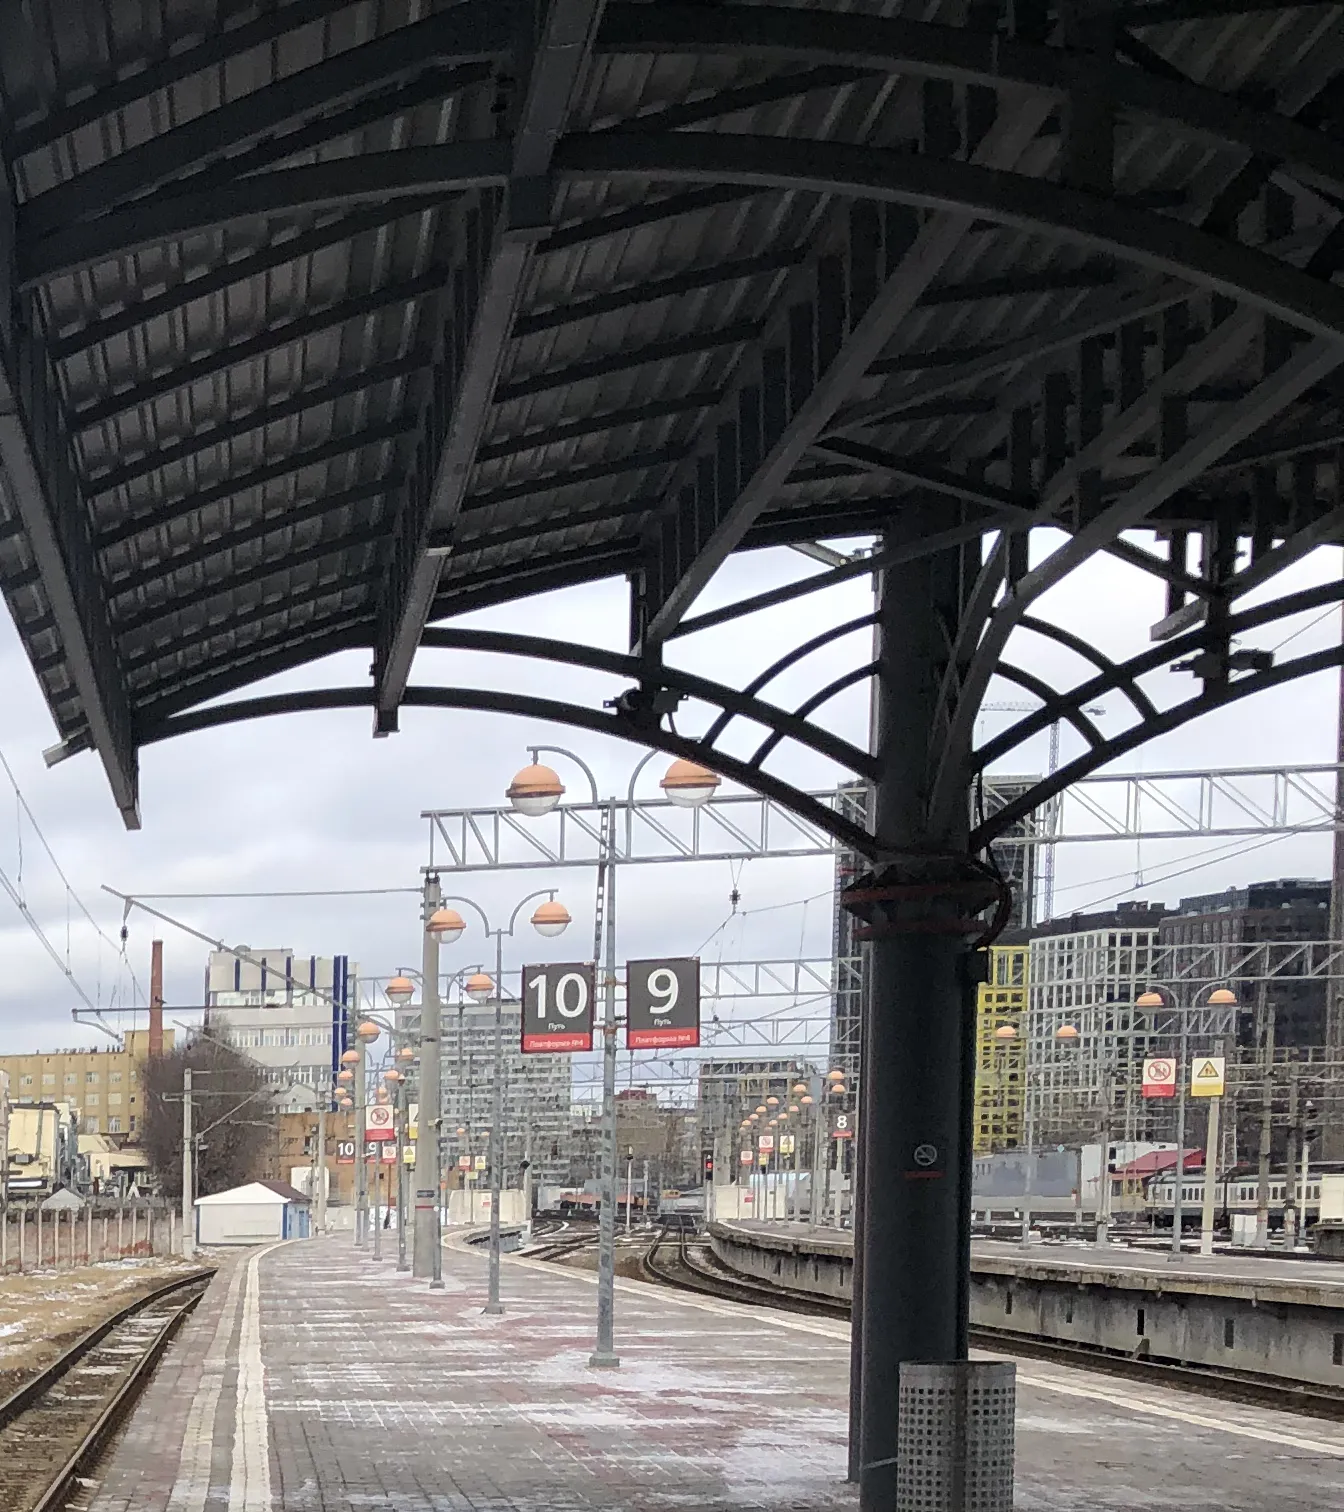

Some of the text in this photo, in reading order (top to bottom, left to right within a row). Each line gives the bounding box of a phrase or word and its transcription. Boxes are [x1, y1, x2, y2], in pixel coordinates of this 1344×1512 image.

[528, 972, 588, 1019] 10
[647, 967, 679, 1014] 9
[548, 1022, 566, 1031] Путь
[653, 1018, 672, 1027] Путь
[836, 1115, 848, 1129] 8
[337, 1142, 354, 1156] 10
[368, 1141, 377, 1155] 9
